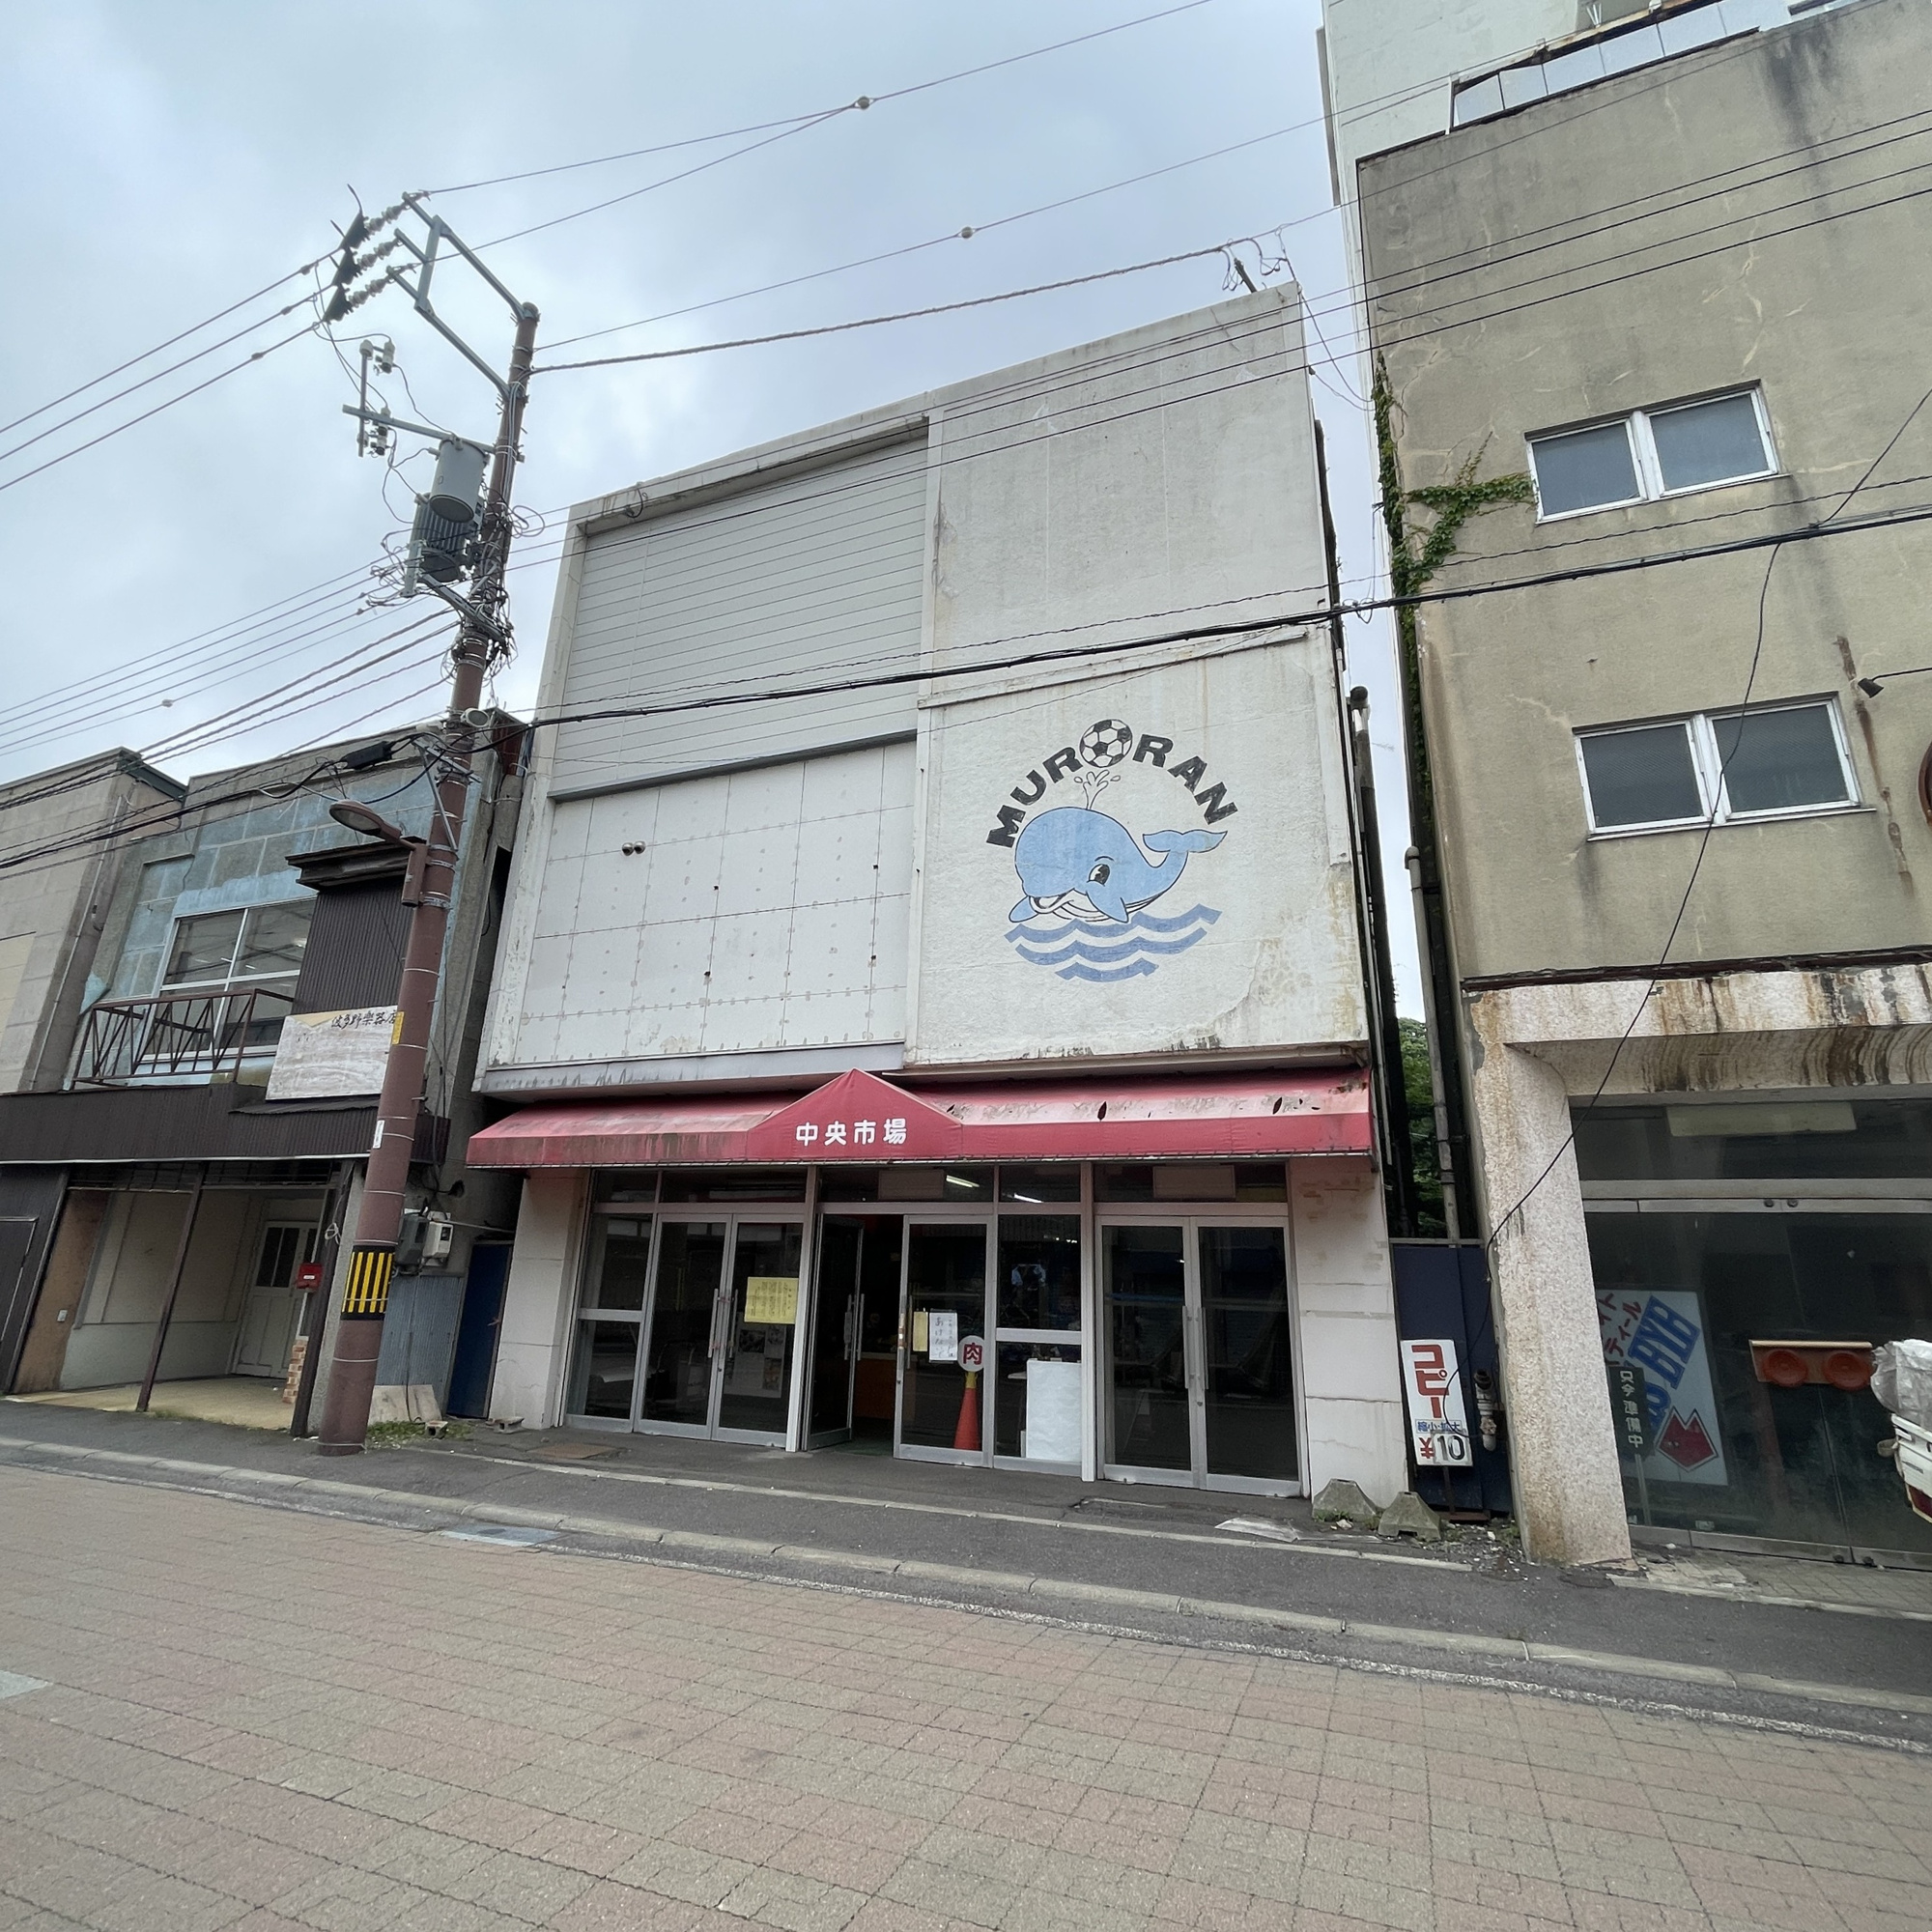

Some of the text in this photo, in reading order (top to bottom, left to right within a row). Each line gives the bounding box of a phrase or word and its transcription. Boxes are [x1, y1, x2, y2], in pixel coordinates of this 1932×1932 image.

[795, 1118, 907, 1147] 中央市場
[963, 1342, 983, 1365] 肉
[1411, 1344, 1450, 1418] コピー
[1619, 1370, 1644, 1448] 只今準備中
